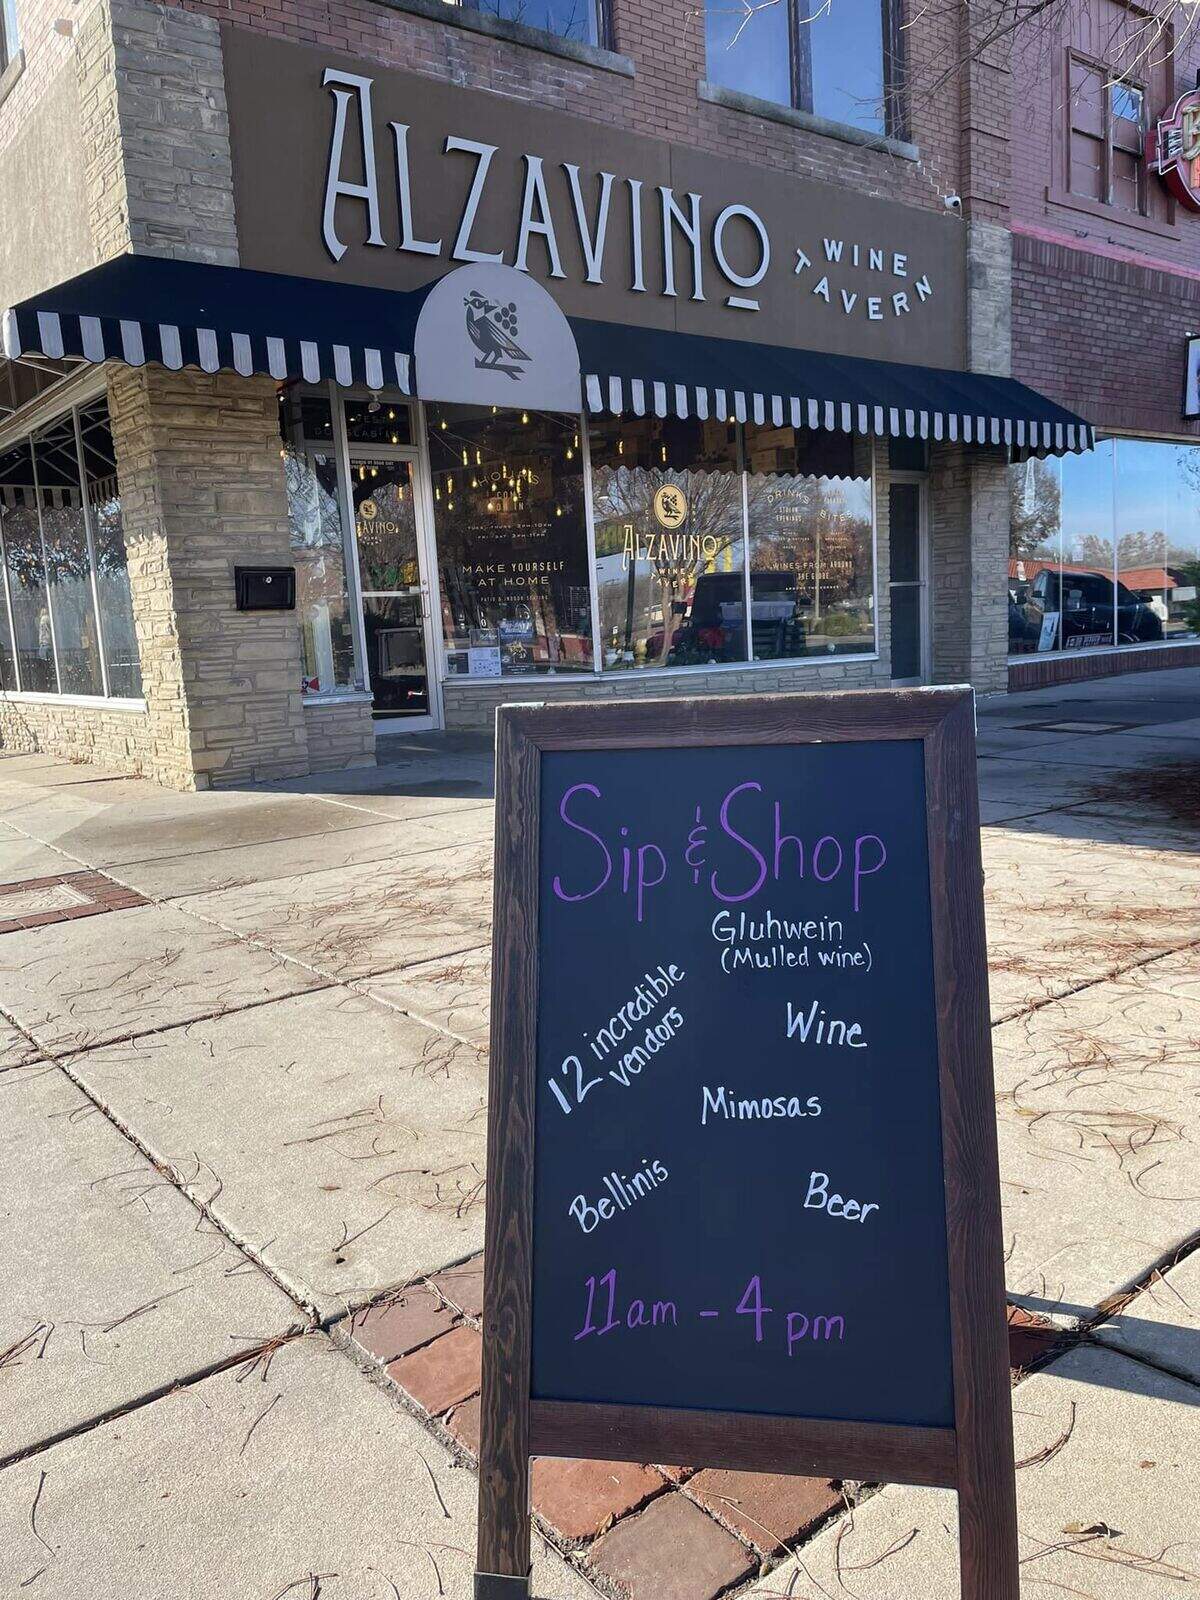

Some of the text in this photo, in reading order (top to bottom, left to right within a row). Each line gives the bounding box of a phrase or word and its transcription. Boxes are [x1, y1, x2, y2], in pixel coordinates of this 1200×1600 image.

[322, 67, 770, 311] ALZAVINO
[823, 238, 907, 277] WINE
[794, 248, 932, 320] TAVERN
[462, 561, 564, 574] MAKE YOURSELF
[622, 524, 717, 571] ALZAVINO
[478, 576, 549, 587] AT HOME
[553, 783, 667, 922] Sip
[711, 782, 887, 912] Shop
[711, 909, 843, 944] Gluhwein
[720, 943, 873, 974] (Mulled wine)
[548, 962, 685, 1114] 12 incredible
[609, 1005, 685, 1087] vendors
[786, 1000, 867, 1048] Wine
[701, 1086, 822, 1125] Mimosas
[568, 1159, 669, 1233] Bellinis
[803, 1171, 879, 1223] Beer
